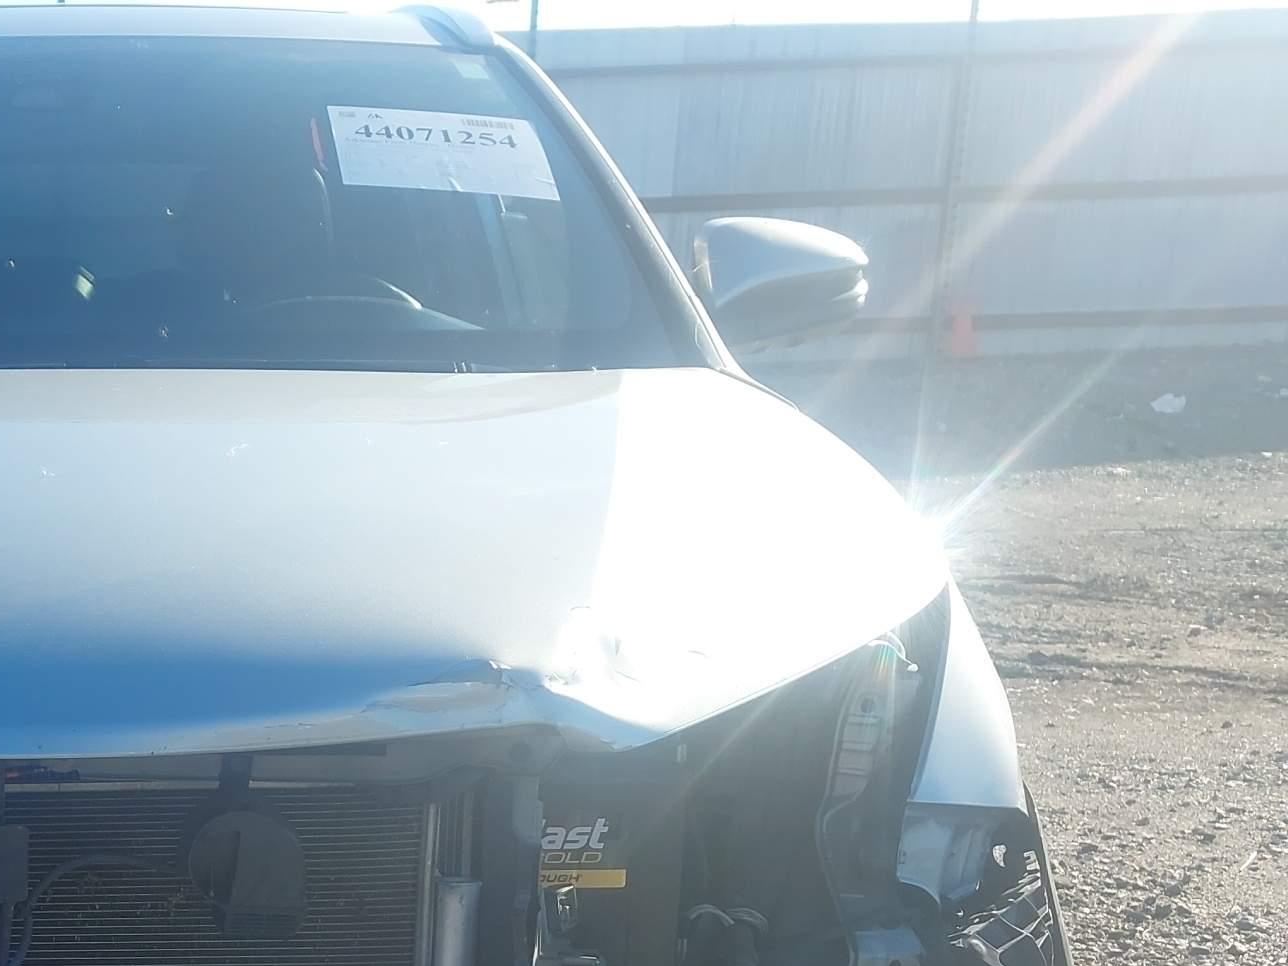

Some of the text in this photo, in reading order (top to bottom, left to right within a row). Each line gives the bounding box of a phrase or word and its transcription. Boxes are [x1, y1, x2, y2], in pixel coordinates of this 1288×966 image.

[355, 124, 518, 149] 44071254
[540, 818, 609, 850] ast
[541, 852, 602, 864] OLD
